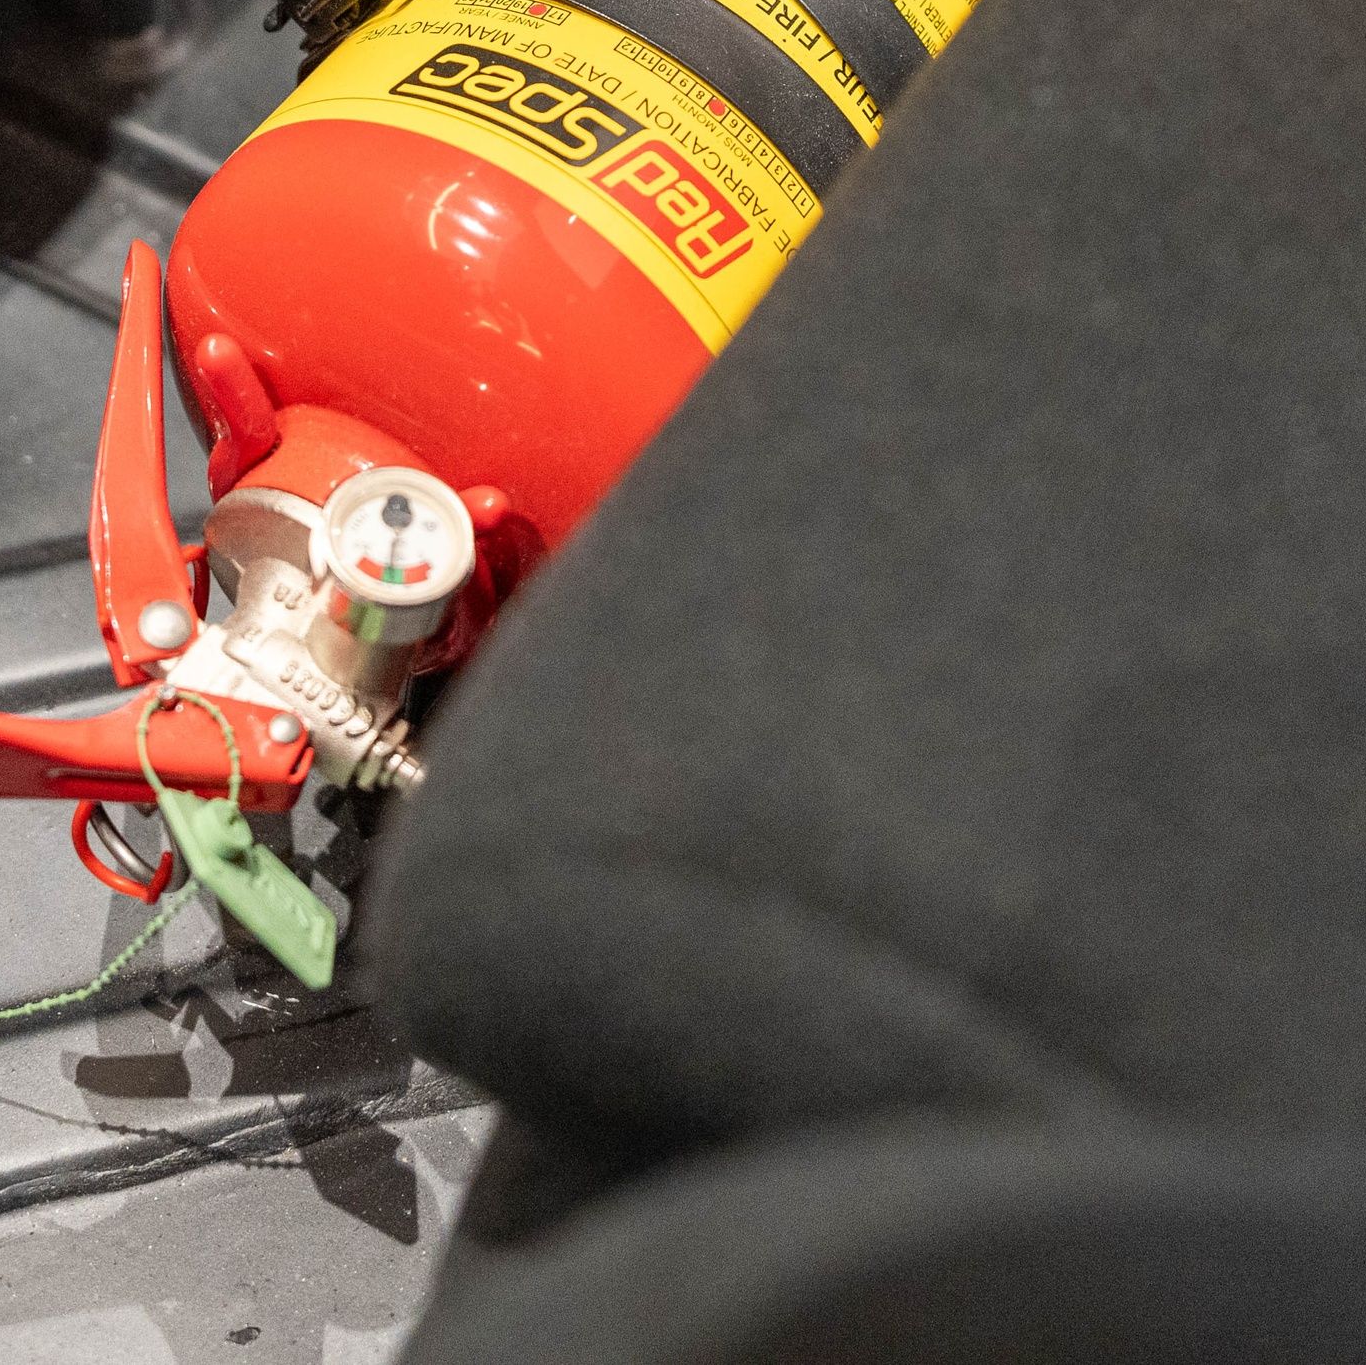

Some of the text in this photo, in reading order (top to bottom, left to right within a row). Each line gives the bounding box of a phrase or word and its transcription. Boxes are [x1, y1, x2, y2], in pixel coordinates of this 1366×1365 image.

[512, 0, 527, 9] 19
[547, 10, 564, 20] 17
[364, 20, 515, 46] MANUFACTURE
[514, 39, 552, 59] OF
[620, 42, 636, 54] 12
[640, 52, 654, 64] 11
[554, 51, 622, 95] DATE
[657, 62, 673, 76] 10
[678, 78, 687, 87] 9
[695, 89, 705, 100] 8
[671, 93, 717, 133] MONTH
[729, 118, 738, 128] 6
[744, 132, 754, 143] 5
[722, 136, 753, 168] MOIS
[759, 148, 768, 157] 4
[395, 55, 752, 275] Red Spec
[635, 97, 776, 233] FABRICATION
[773, 164, 783, 175] 3
[786, 180, 796, 191] 2
